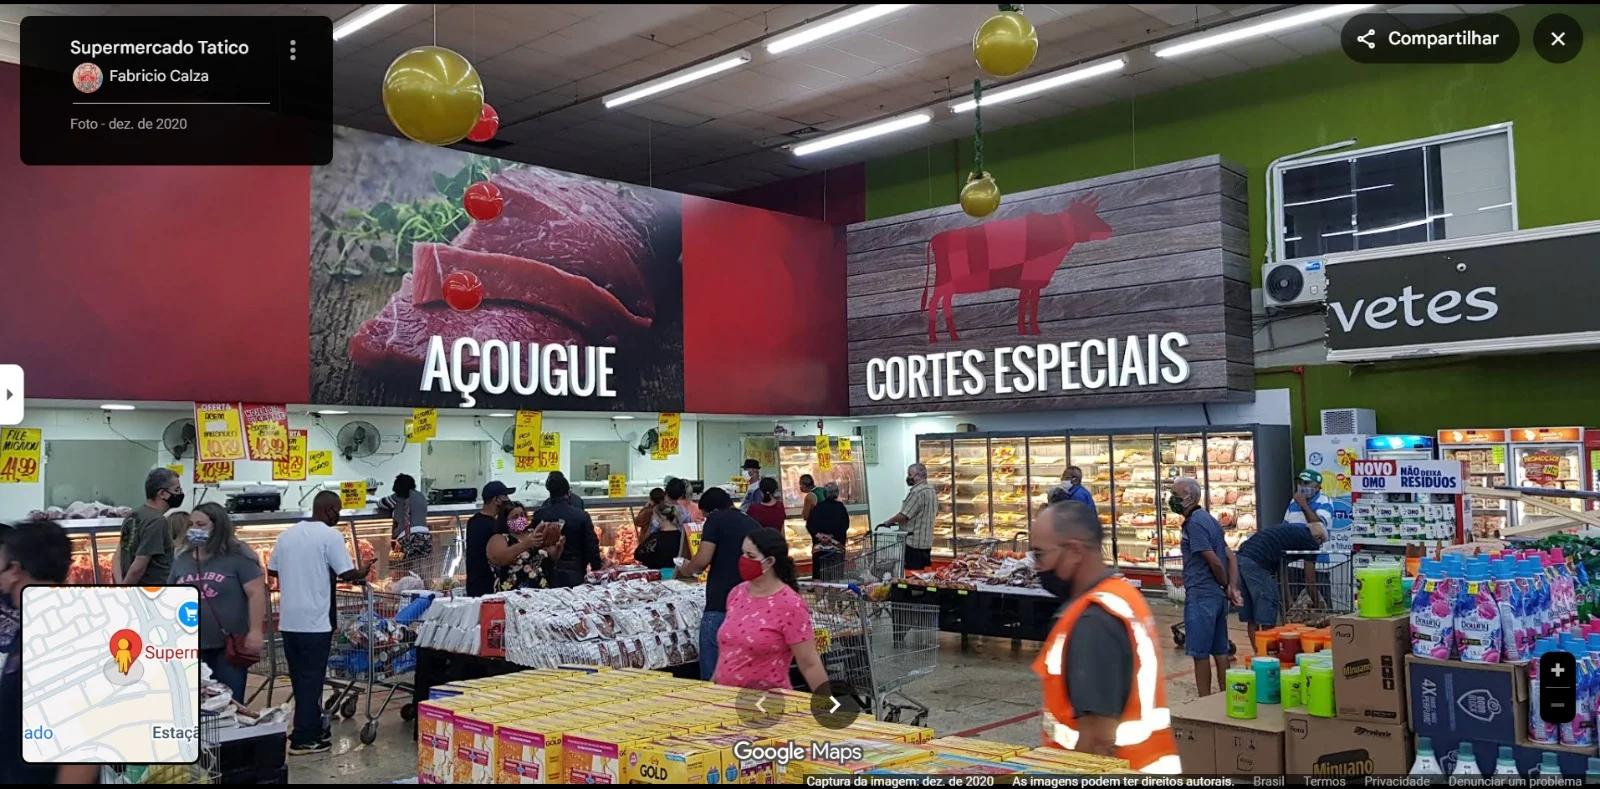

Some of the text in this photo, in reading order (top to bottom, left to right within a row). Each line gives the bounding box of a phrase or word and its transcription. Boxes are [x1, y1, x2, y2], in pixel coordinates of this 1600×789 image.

[1328, 285, 1499, 333] vetes
[420, 334, 617, 408] AÇOUGUE
[865, 331, 1191, 402] CORTES ESPECIAIS
[1354, 462, 1393, 476] NOVO
[1400, 465, 1420, 476] NÃO
[1362, 476, 1386, 488] OMO
[1416, 616, 1440, 629] Downy
[1462, 620, 1489, 632] Downy
[1343, 662, 1373, 677] Minuano
[1422, 678, 1438, 696] 4X
[546, 738, 562, 746] GOLD
[640, 764, 668, 781] GOLD
[1313, 759, 1374, 777] Minuano
